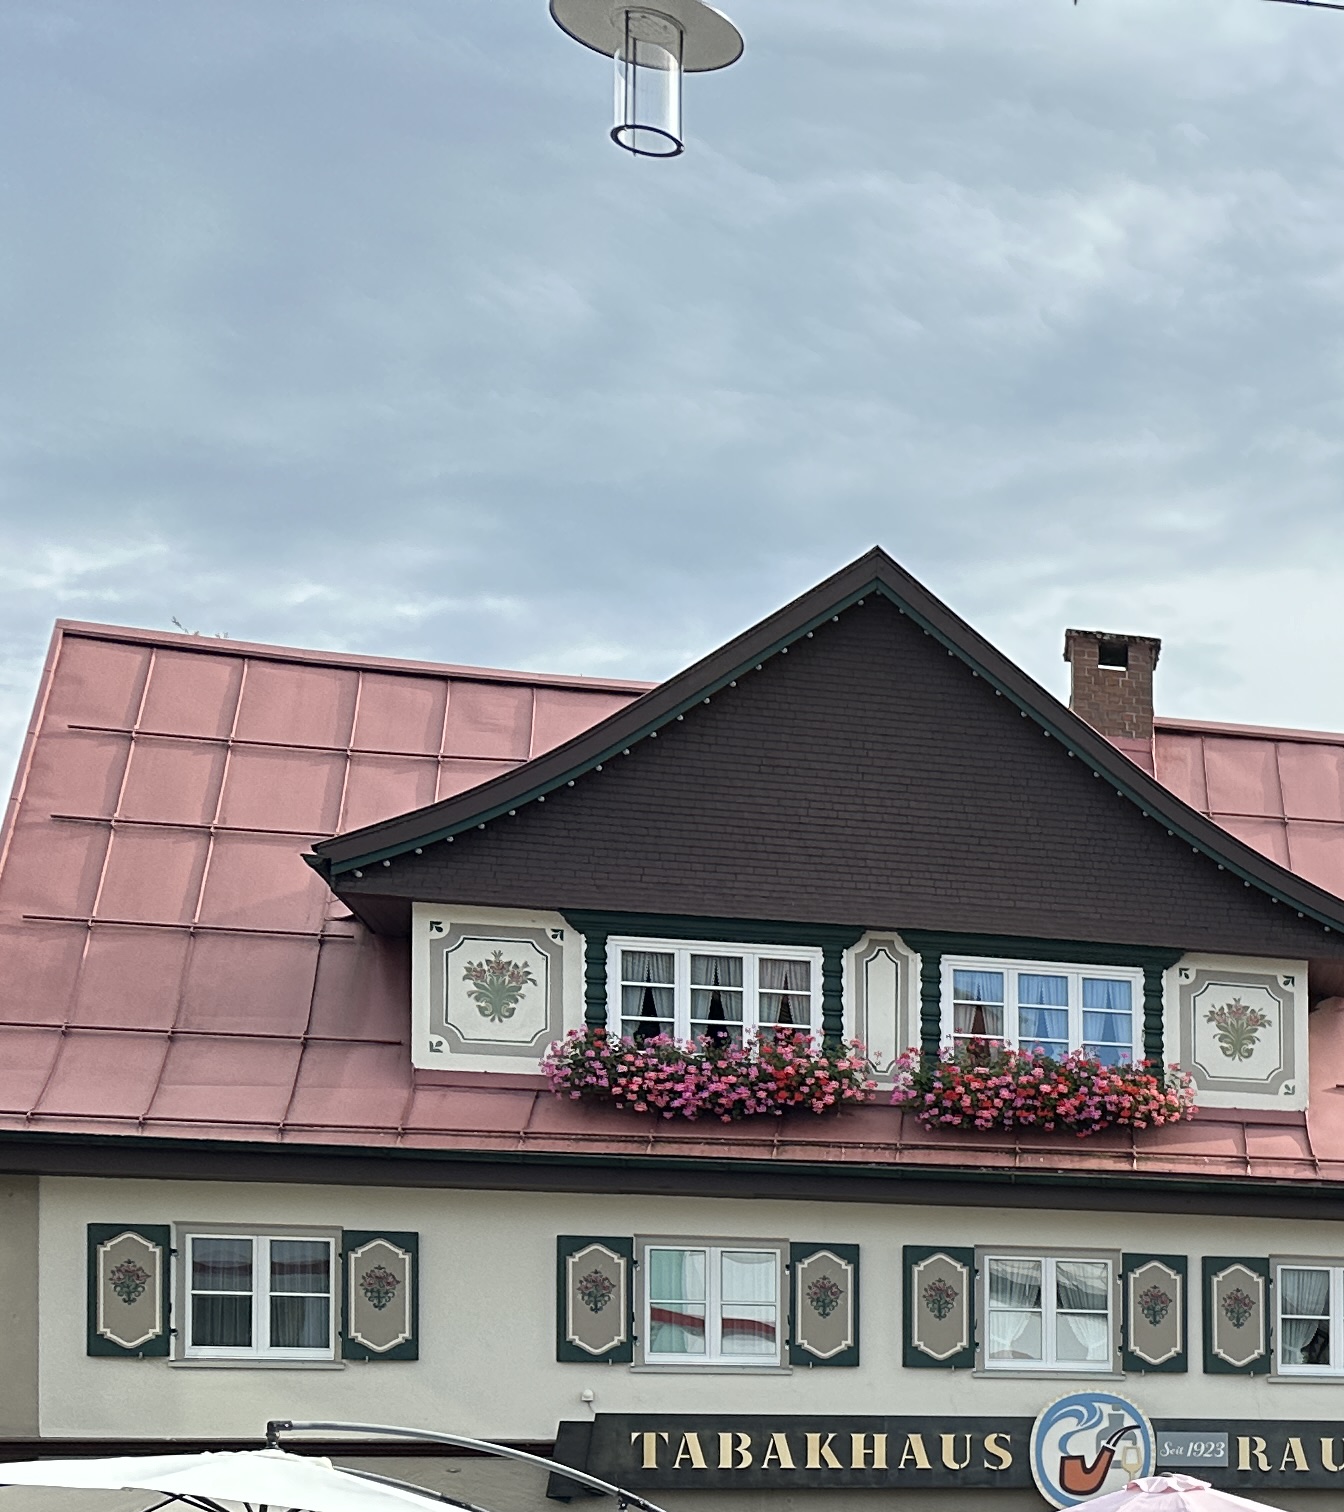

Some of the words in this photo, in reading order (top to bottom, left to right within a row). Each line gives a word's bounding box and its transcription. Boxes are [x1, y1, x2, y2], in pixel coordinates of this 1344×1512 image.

[630, 1431, 1013, 1471] TABAKHAUS
[1160, 1442, 1184, 1456] Seit
[1186, 1441, 1225, 1458] 1923
